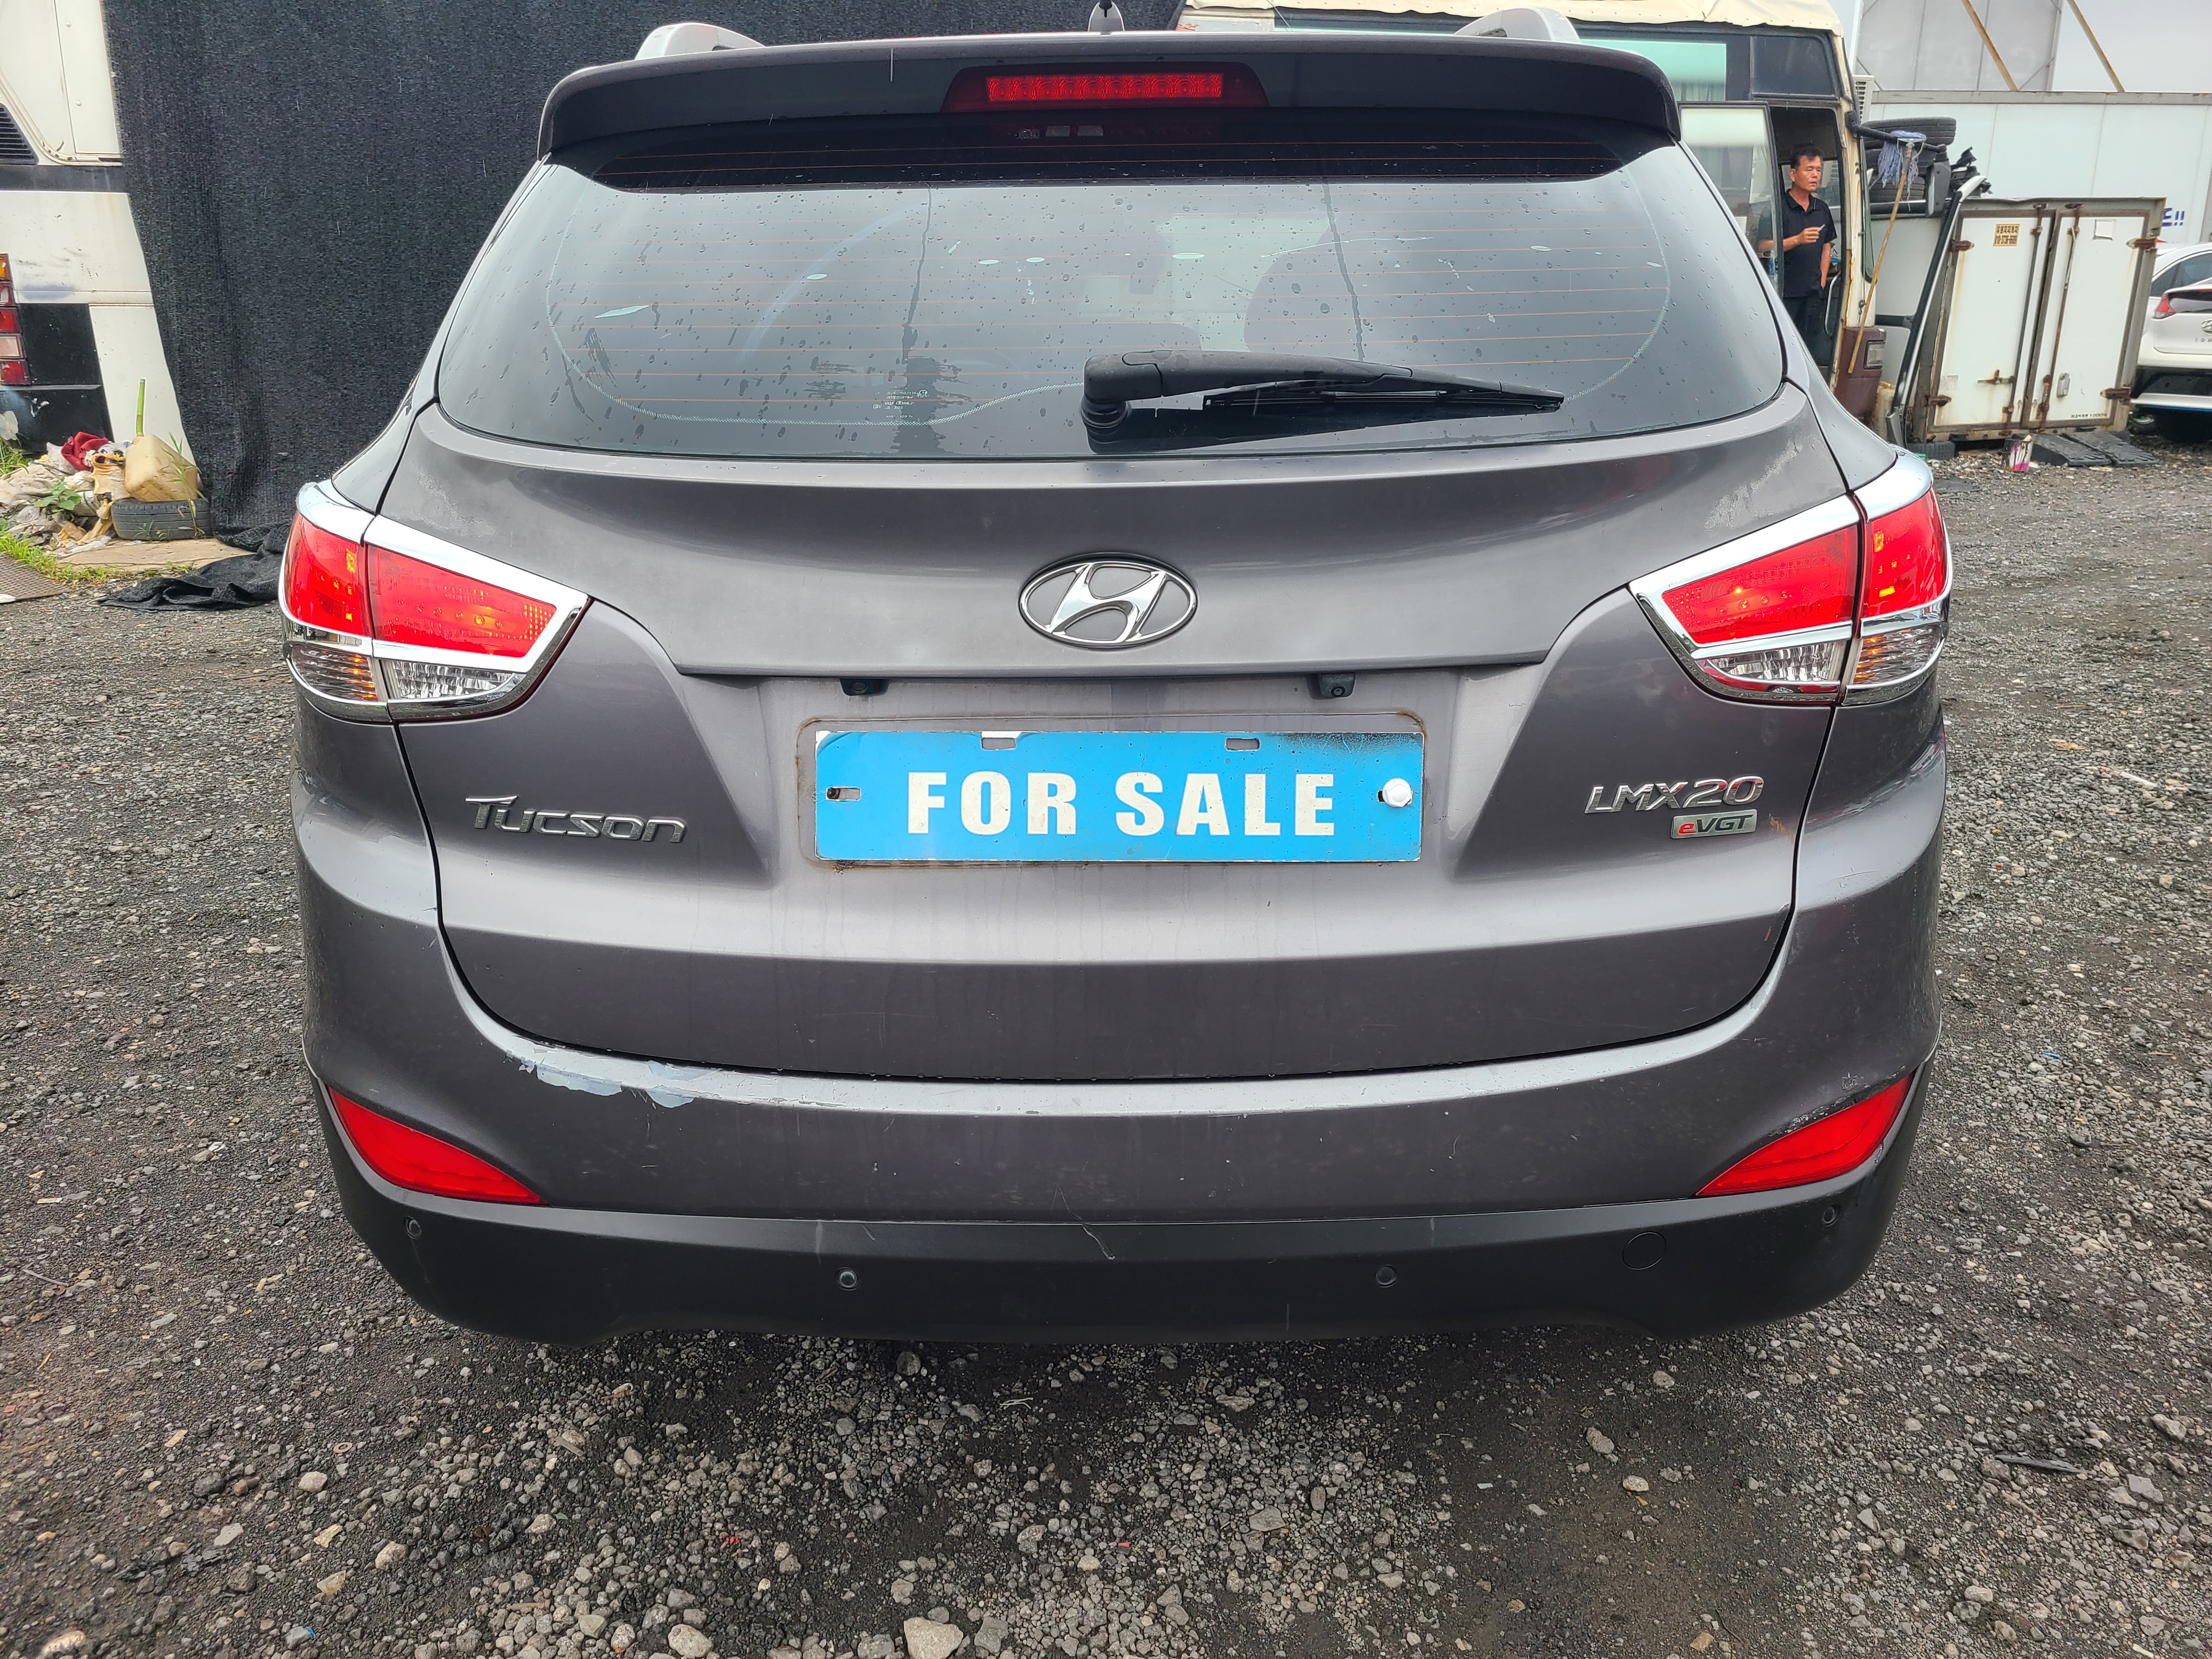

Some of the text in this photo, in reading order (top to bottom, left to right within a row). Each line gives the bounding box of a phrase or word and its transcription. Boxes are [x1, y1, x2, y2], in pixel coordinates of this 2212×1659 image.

[909, 771, 1334, 836] FOR SALE
[1584, 775, 1764, 814] LMX20
[1678, 814, 1754, 835] eVGT
